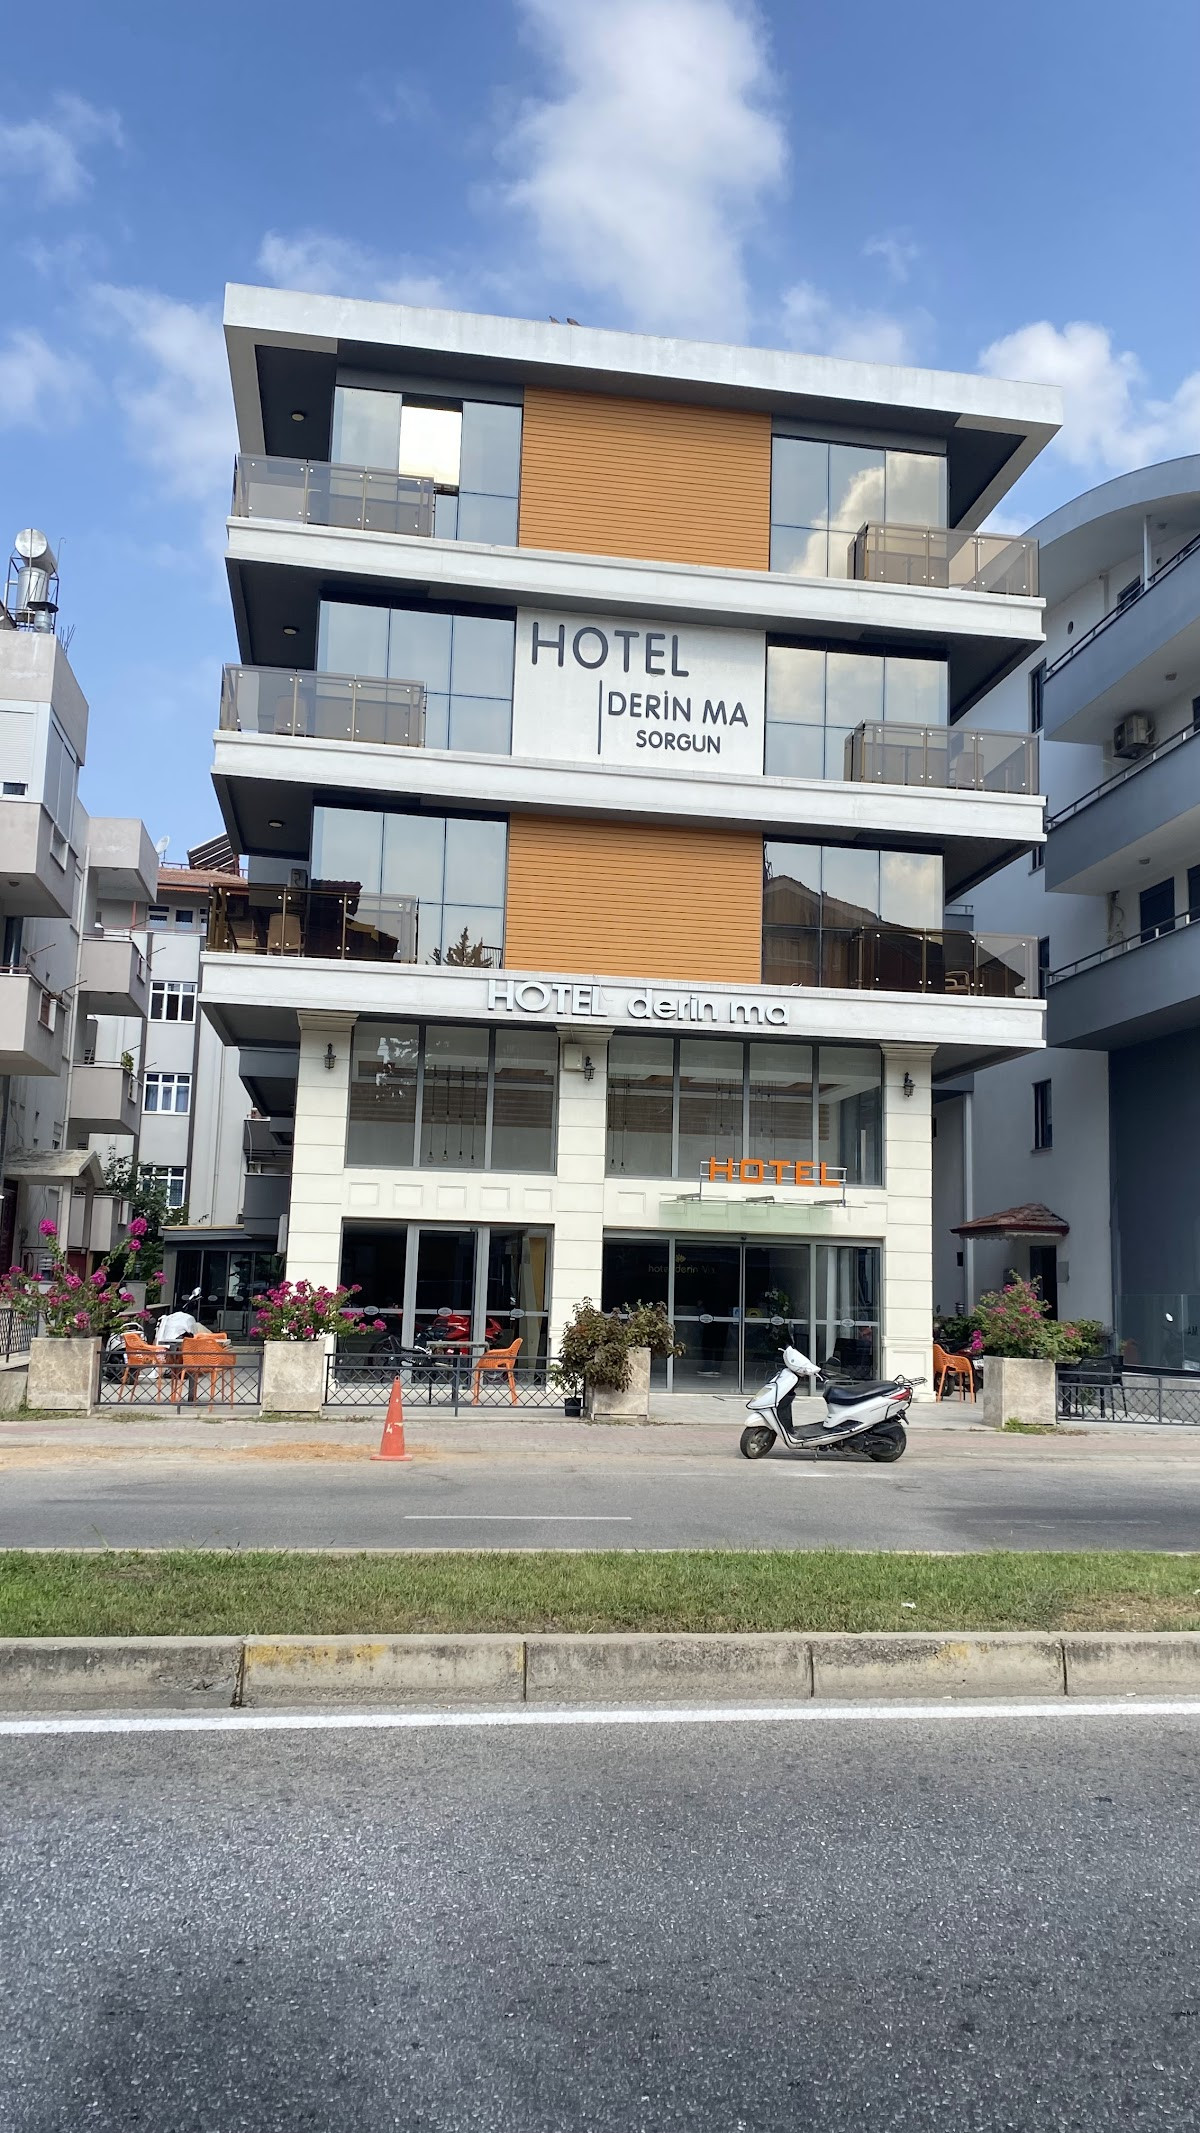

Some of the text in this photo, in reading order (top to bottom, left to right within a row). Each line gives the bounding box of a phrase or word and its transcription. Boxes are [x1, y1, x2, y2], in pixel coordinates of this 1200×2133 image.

[532, 621, 689, 677] HOTEL
[608, 690, 749, 728] DERİN MA
[635, 729, 721, 754] SORGUN
[487, 978, 789, 1026] HOTEL derin ma
[709, 1156, 841, 1187] HOTEL
[647, 1263, 669, 1274] hote
